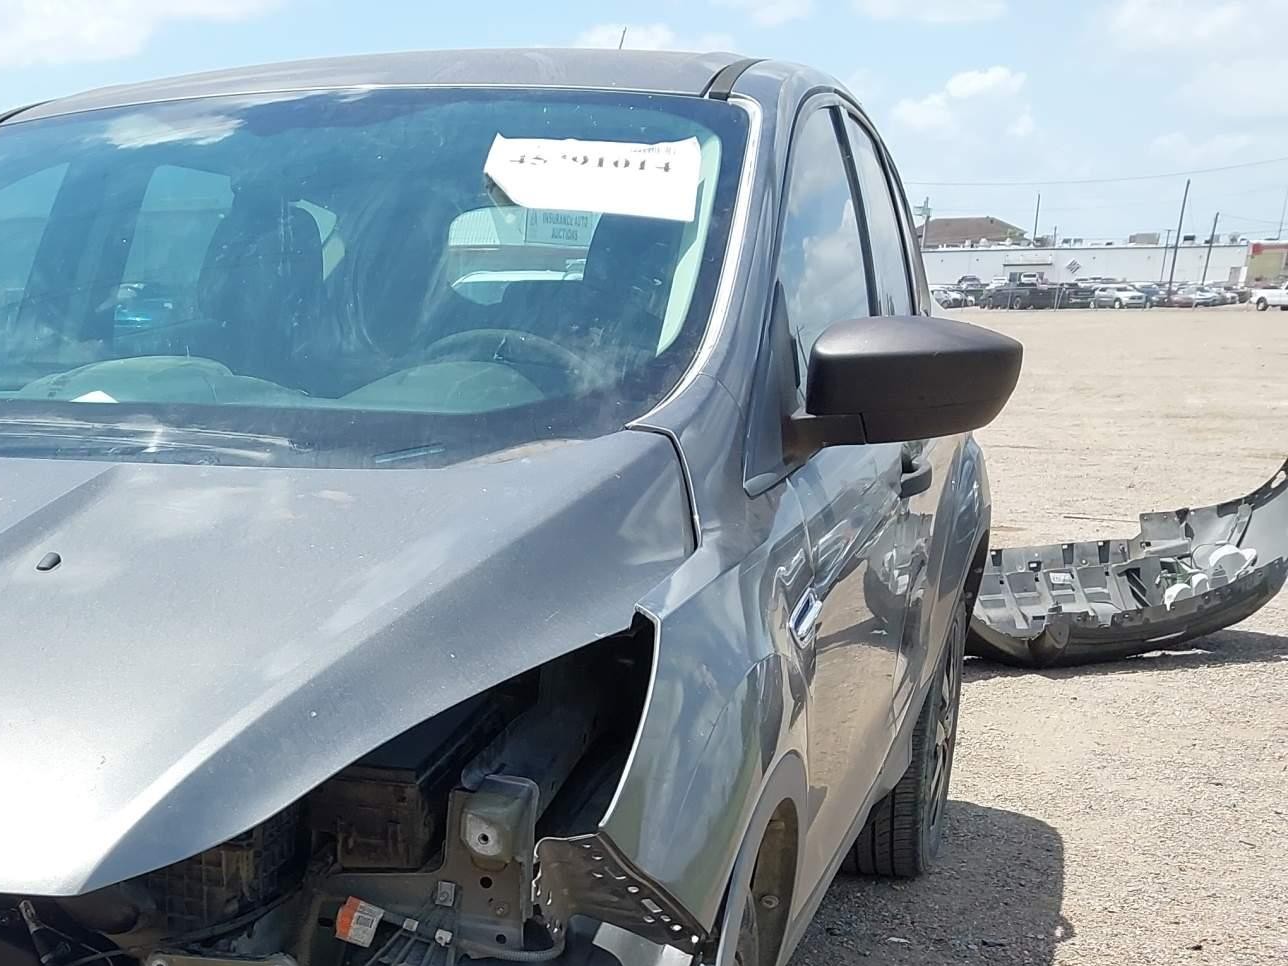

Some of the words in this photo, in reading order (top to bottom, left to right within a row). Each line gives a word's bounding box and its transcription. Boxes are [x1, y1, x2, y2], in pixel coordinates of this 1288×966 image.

[542, 211, 573, 226] INSURANCE
[574, 214, 589, 228] AUTO
[551, 226, 579, 241] AUCTIONS
